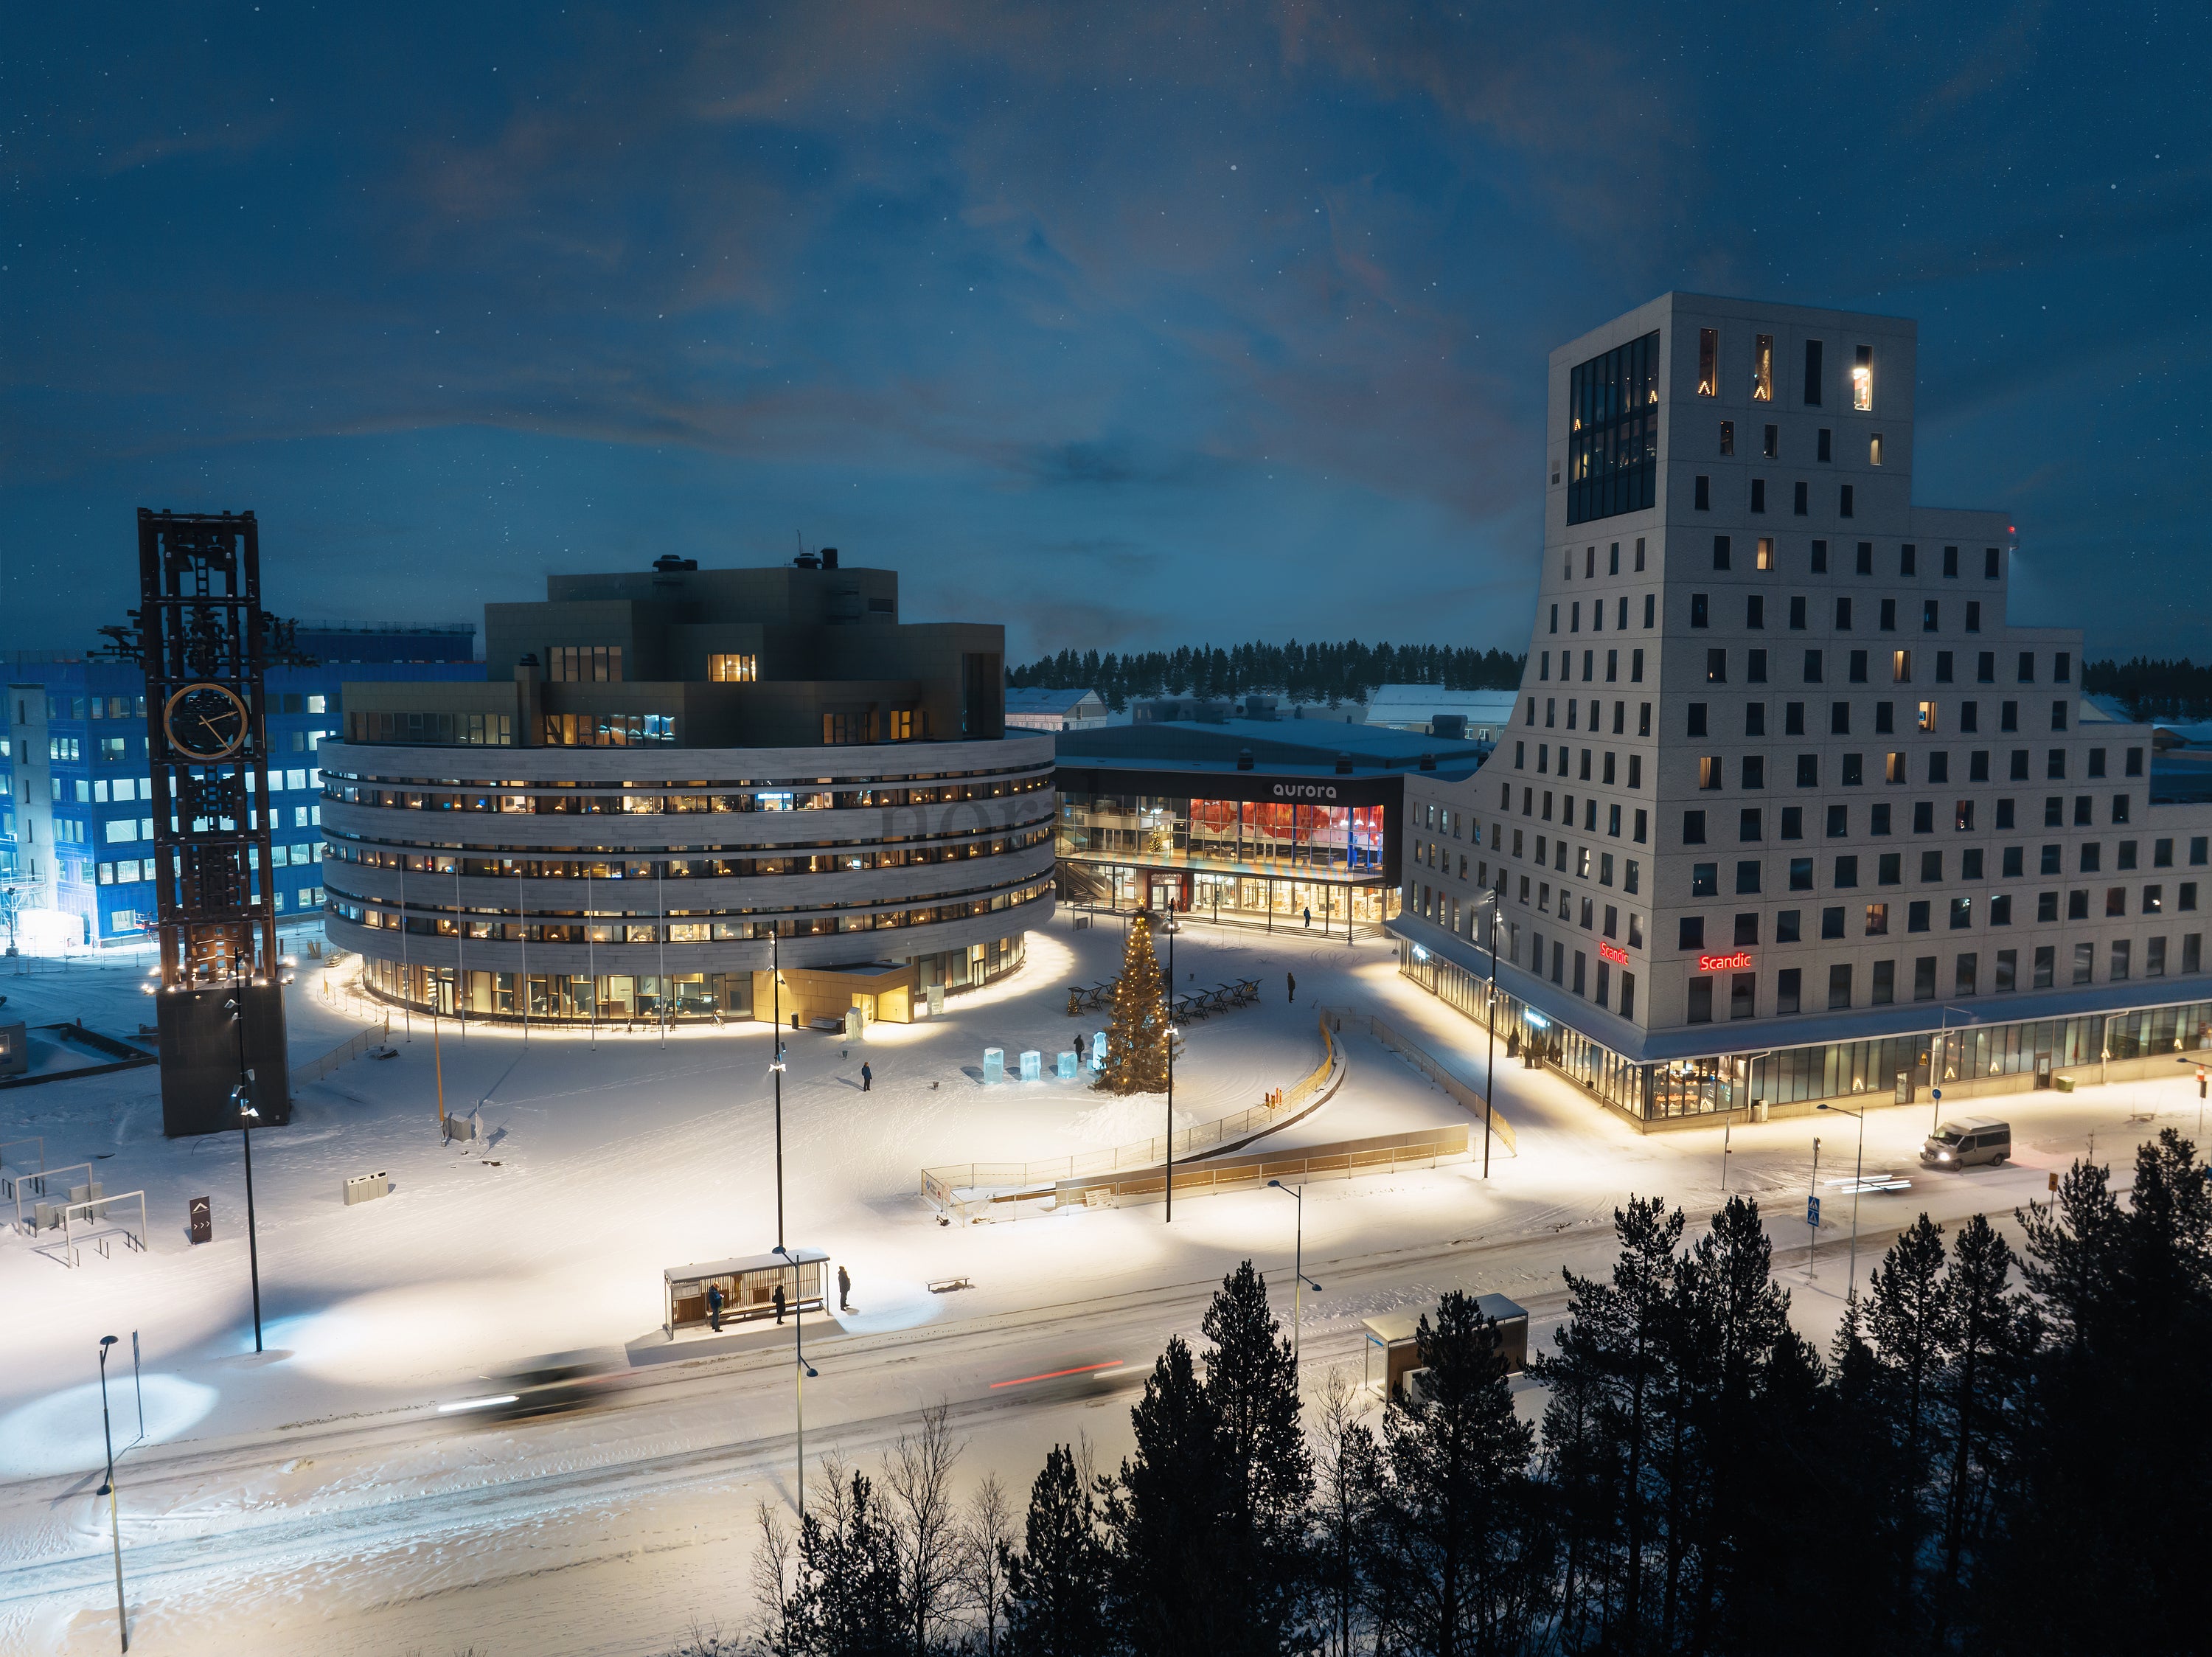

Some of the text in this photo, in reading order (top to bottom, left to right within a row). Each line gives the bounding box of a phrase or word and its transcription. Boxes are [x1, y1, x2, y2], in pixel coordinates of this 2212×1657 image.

[1273, 784, 1337, 799] aurora
[1599, 942, 1629, 966] Scandic
[1699, 952, 1751, 971] Scandic
